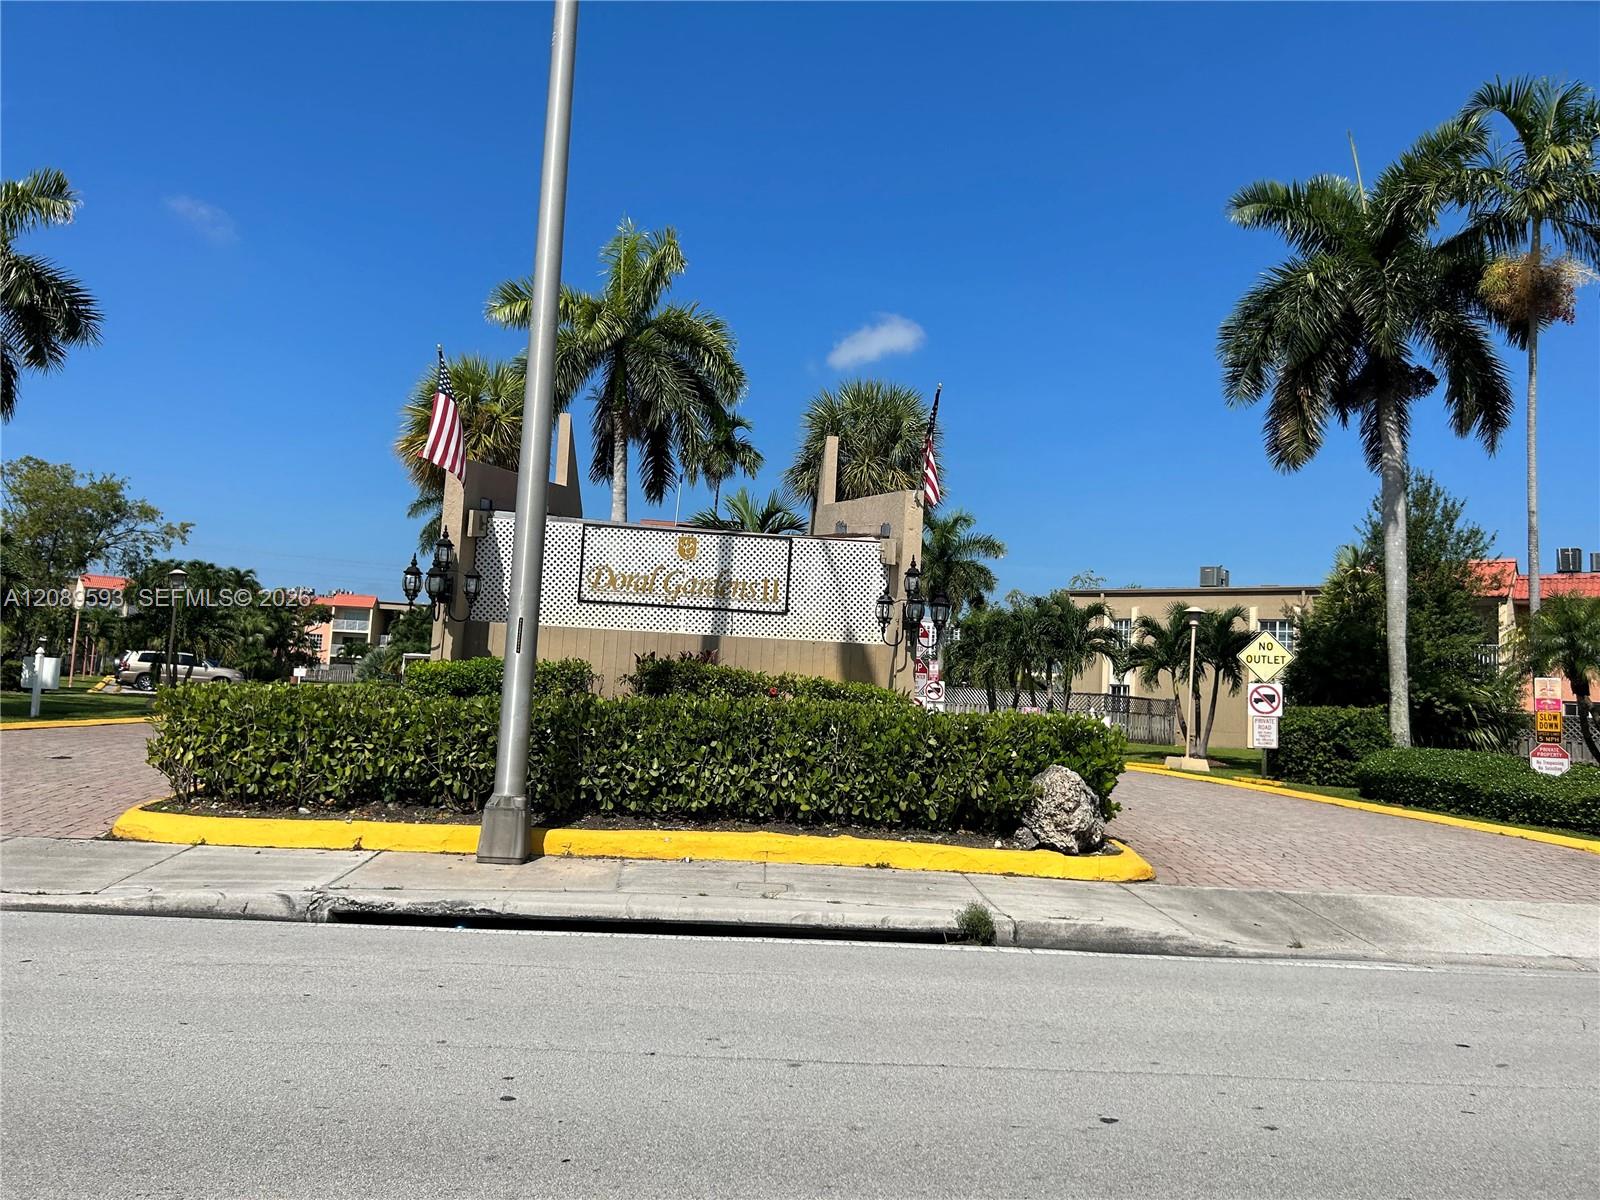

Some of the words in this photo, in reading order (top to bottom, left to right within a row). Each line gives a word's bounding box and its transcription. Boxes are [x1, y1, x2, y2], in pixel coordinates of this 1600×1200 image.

[587, 564, 665, 593] Doral
[663, 569, 758, 602] Gardens
[1259, 642, 1273, 651] NO
[1246, 655, 1286, 664] OUTLET
[1539, 713, 1558, 721] SLOW
[1539, 722, 1559, 730] DOWN
